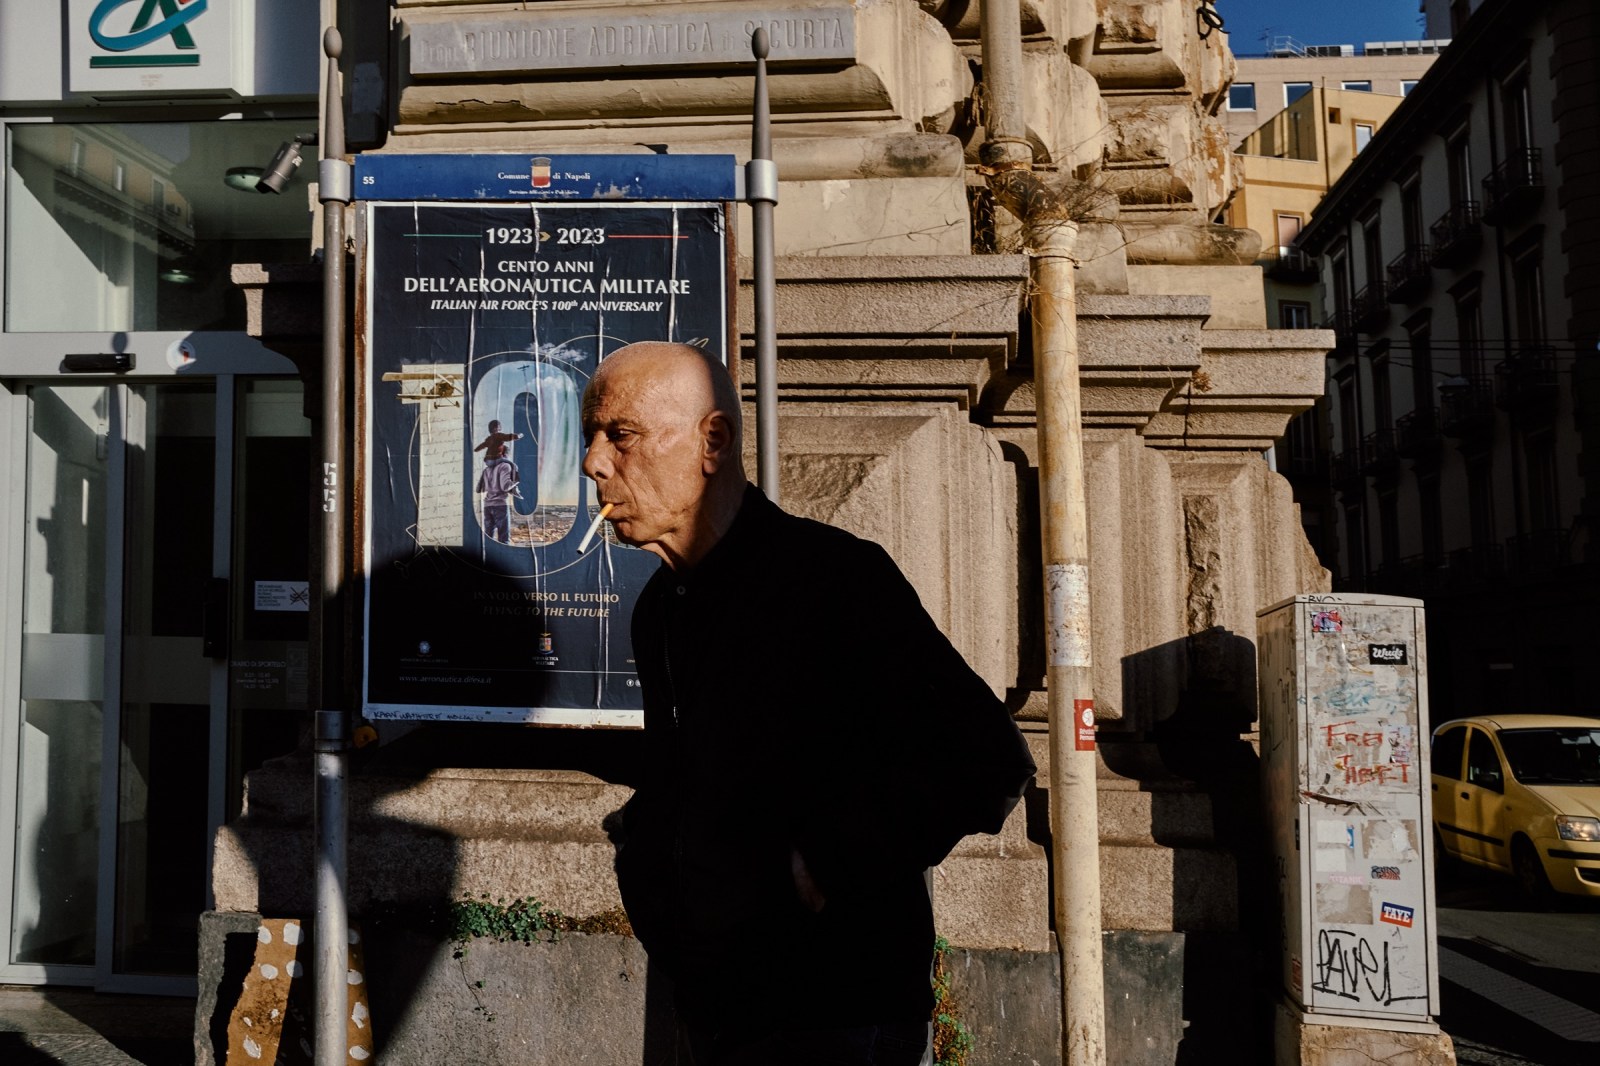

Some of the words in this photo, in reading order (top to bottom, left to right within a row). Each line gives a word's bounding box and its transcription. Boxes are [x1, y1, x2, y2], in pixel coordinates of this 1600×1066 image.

[464, 27, 576, 62] RIUNIONE
[589, 21, 714, 57] ADRIATICA
[744, 12, 845, 50] SCURTÀ
[362, 175, 375, 185] 55
[497, 171, 530, 180] Comune
[552, 172, 561, 180] di
[564, 172, 591, 182] Napoli
[486, 227, 533, 244] 1923
[556, 227, 605, 245] 2023
[497, 260, 550, 273] CENTO
[553, 260, 594, 273] ANNI
[404, 277, 596, 293] DELL'AERONAUTICA
[601, 279, 690, 294] MILITARE
[430, 299, 477, 310] ITALIAN
[478, 300, 499, 310] AIR
[579, 301, 663, 312] ANNIVERSARY
[523, 592, 558, 602] VERSO
[561, 592, 571, 602] IL
[574, 593, 620, 603] FUTURO
[526, 606, 541, 616] TO
[543, 607, 565, 617] THE
[567, 607, 610, 617] FUTURE
[1383, 905, 1411, 923] TAYE
